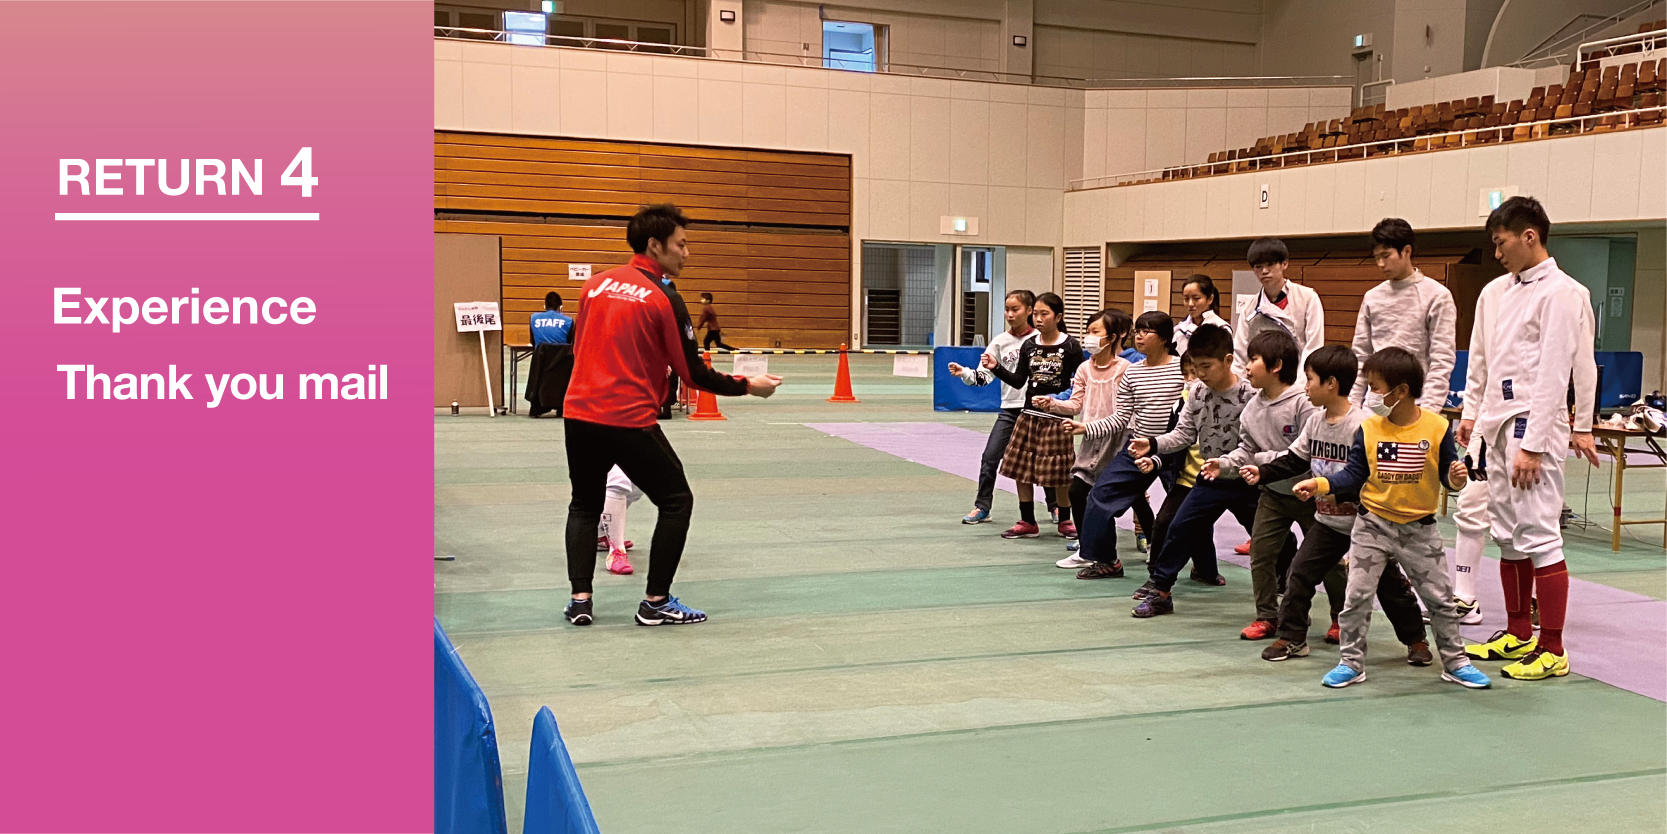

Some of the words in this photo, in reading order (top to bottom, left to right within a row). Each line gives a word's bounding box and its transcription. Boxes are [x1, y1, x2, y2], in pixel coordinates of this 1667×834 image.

[1262, 190, 1267, 202] D
[588, 277, 652, 299] JAPAN
[460, 313, 496, 326] 最後尾
[534, 318, 565, 328] STAFF
